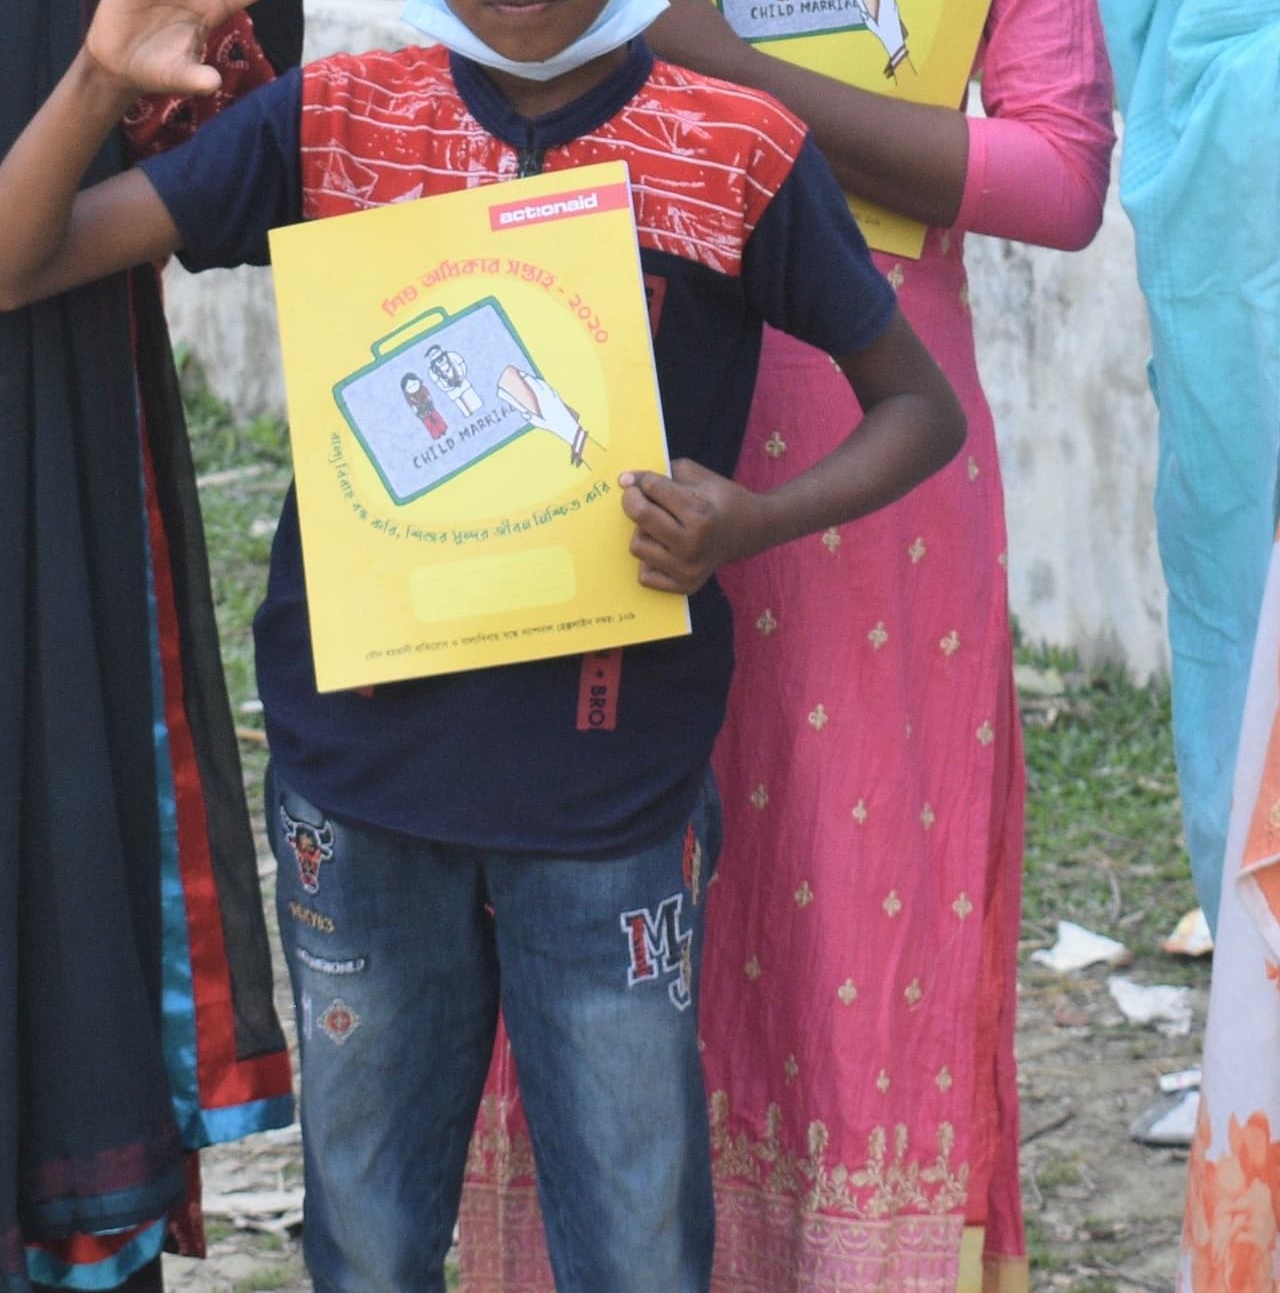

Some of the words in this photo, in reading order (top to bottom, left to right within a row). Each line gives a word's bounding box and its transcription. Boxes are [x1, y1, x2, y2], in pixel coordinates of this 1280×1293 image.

[750, 4, 794, 19] CHILD
[421, 258, 500, 288] অধিকার
[507, 260, 555, 290] সপ্তাহ
[568, 294, 609, 344] ২০২০
[412, 439, 456, 469] CHILD
